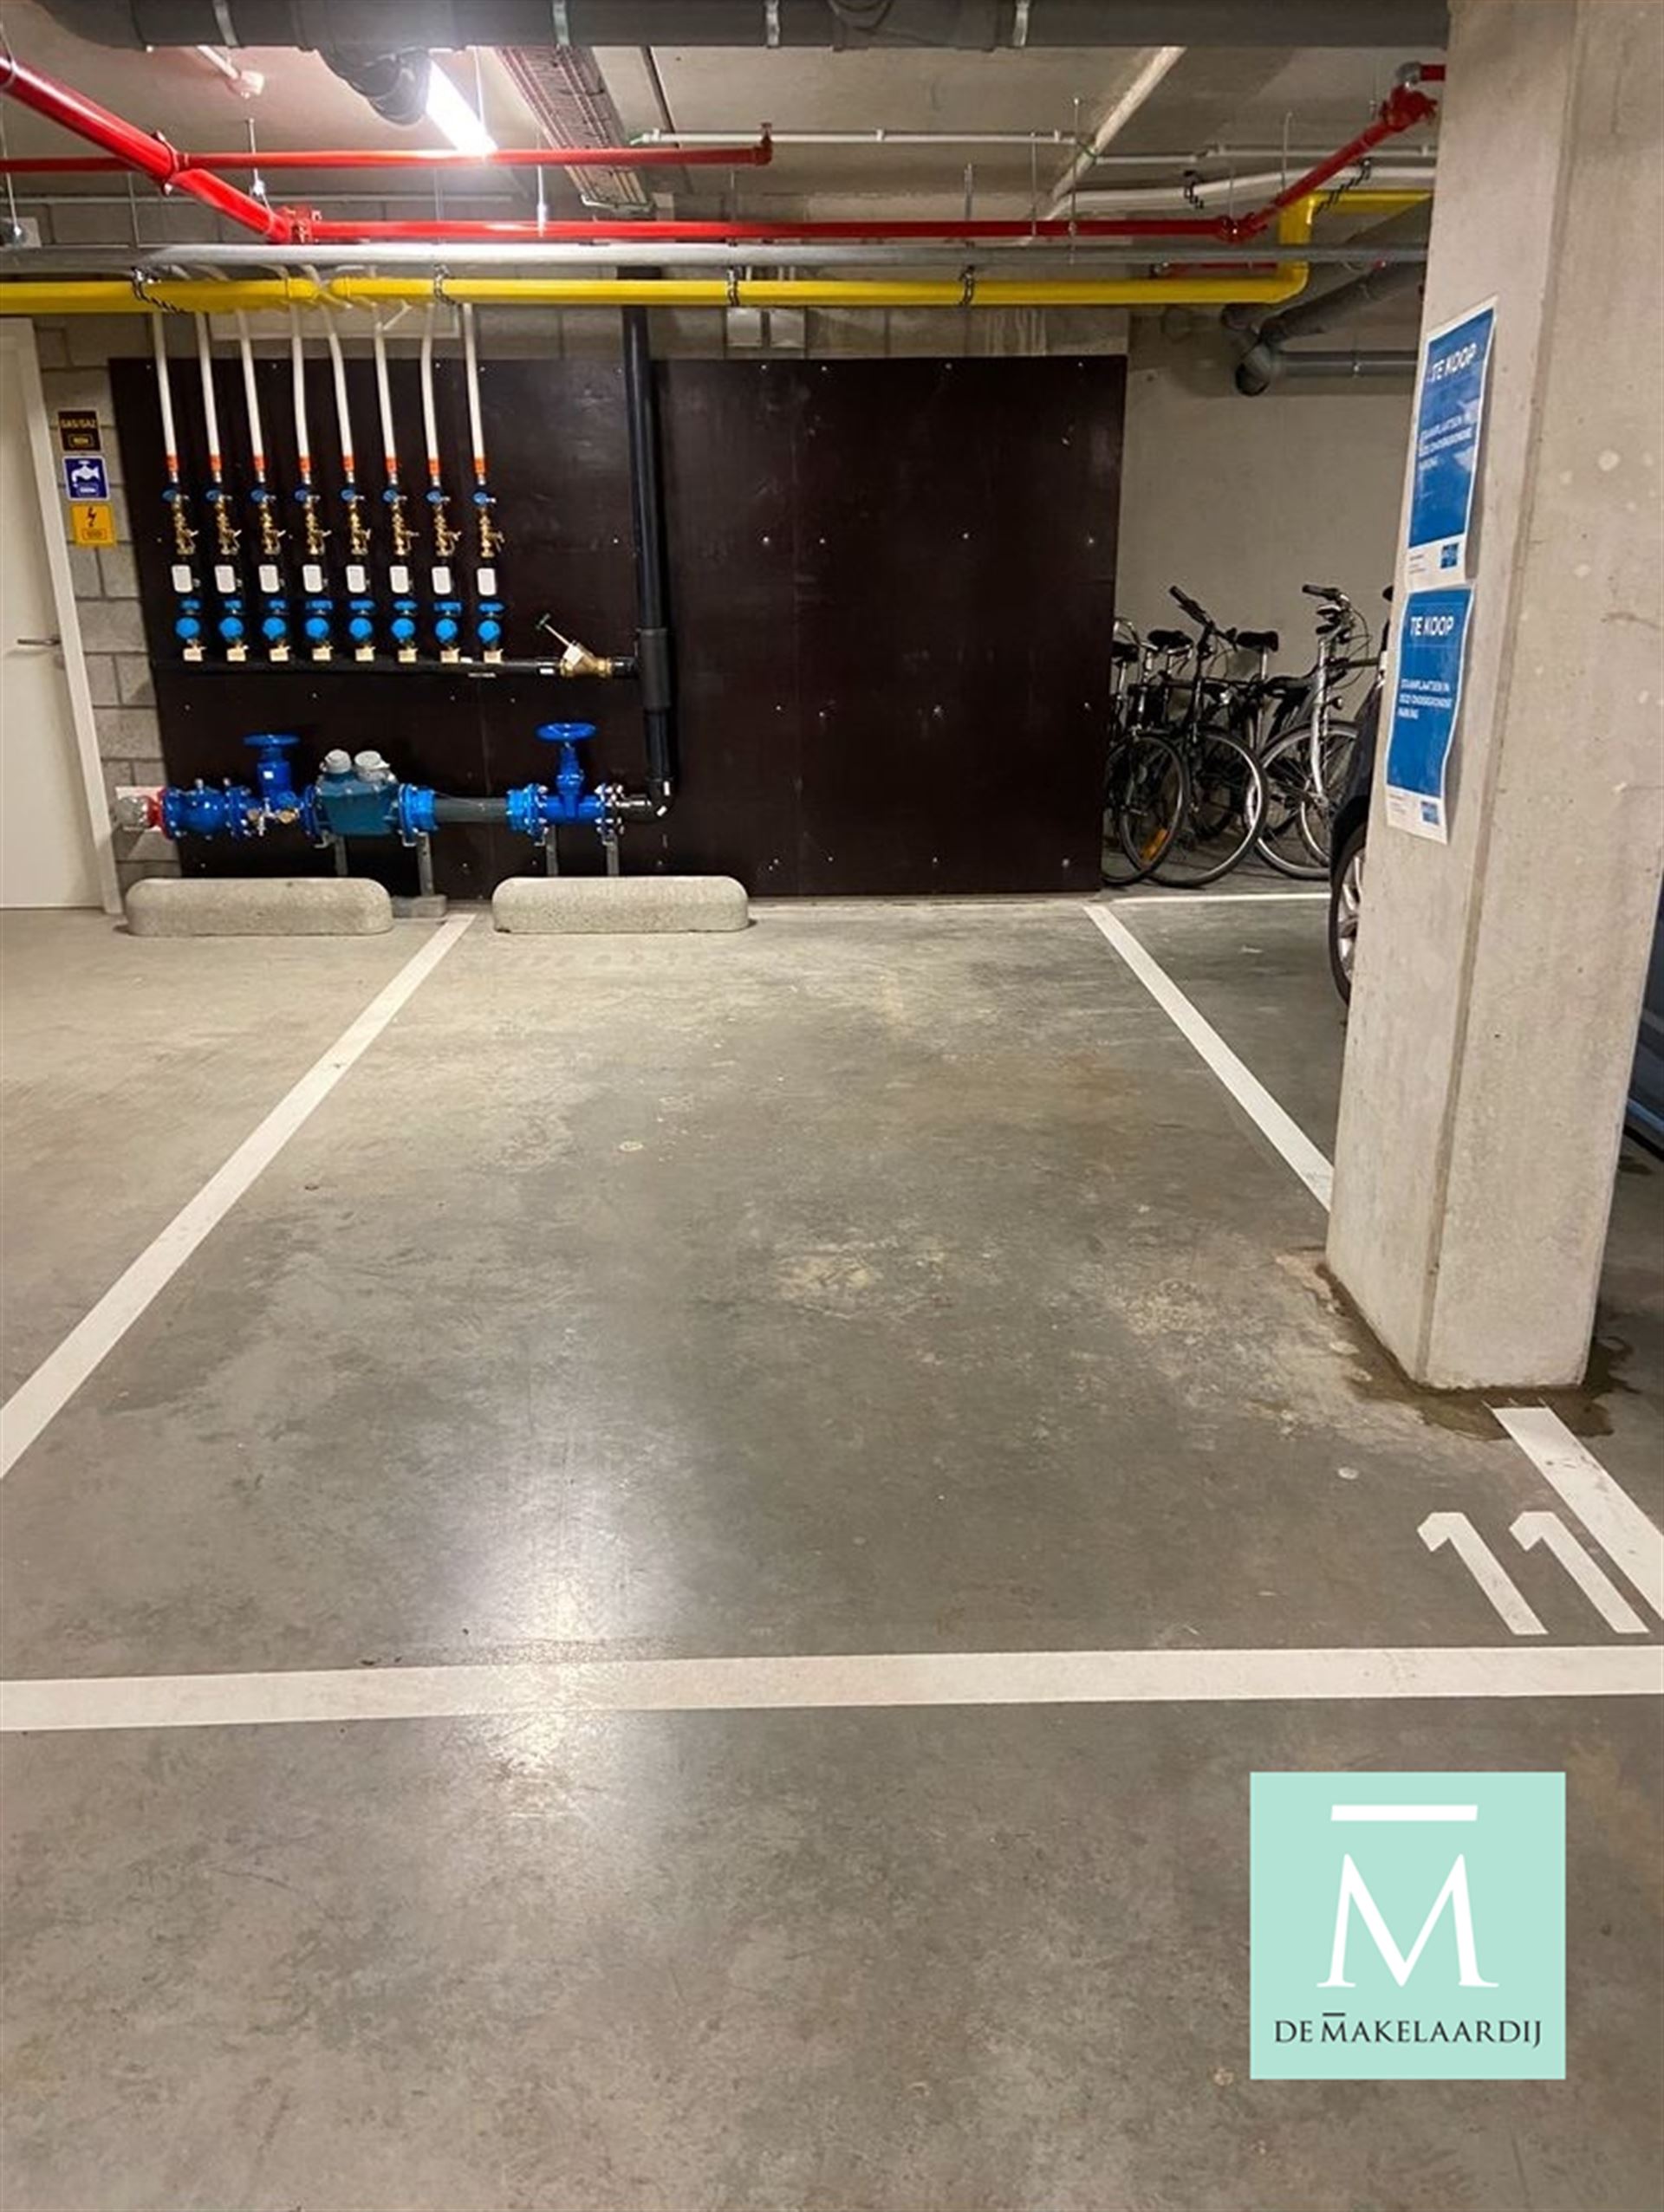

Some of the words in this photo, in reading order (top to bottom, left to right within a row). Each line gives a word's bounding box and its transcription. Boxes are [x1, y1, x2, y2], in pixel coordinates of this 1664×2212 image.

[1429, 360, 1445, 382] TE
[1445, 343, 1477, 377] KOOP
[1410, 616, 1423, 636] TE
[1423, 616, 1454, 636] KOOP
[1417, 1511, 1650, 1635] 11
